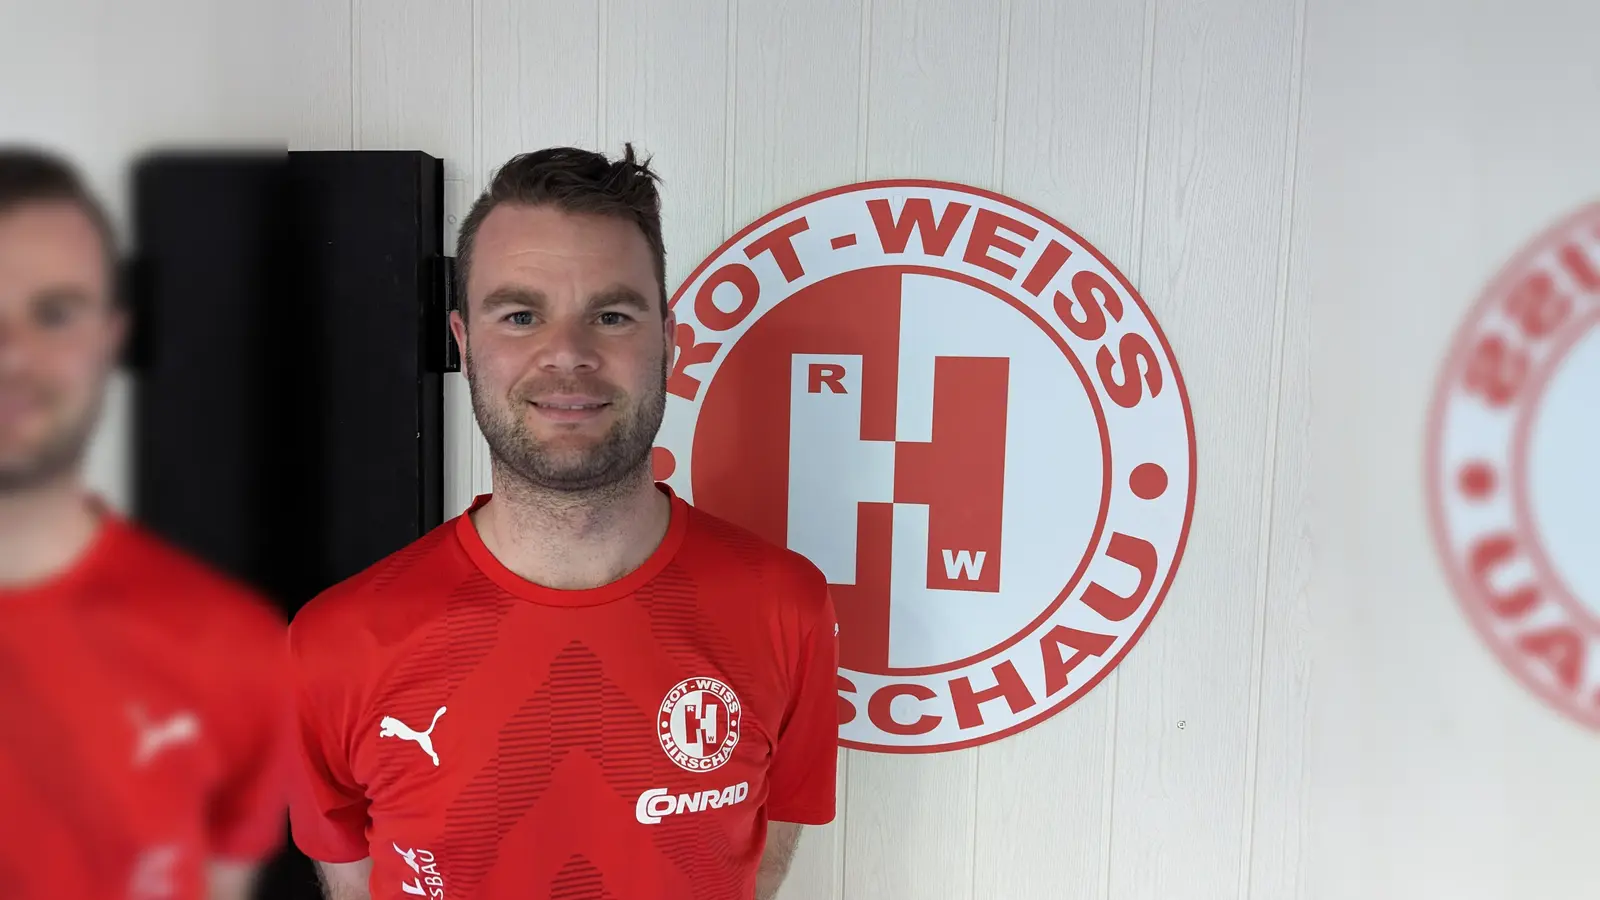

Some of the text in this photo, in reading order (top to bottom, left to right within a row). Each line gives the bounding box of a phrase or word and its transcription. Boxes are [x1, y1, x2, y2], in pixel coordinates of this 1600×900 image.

[666, 197, 1163, 409] ROT-WEISS
[807, 363, 848, 394] R
[941, 549, 986, 580] W
[662, 679, 738, 714] ROT-WEISS
[661, 731, 737, 769] HIRSCHAU
[635, 781, 749, 825] CONRAD
[416, 848, 444, 900] SBAU
